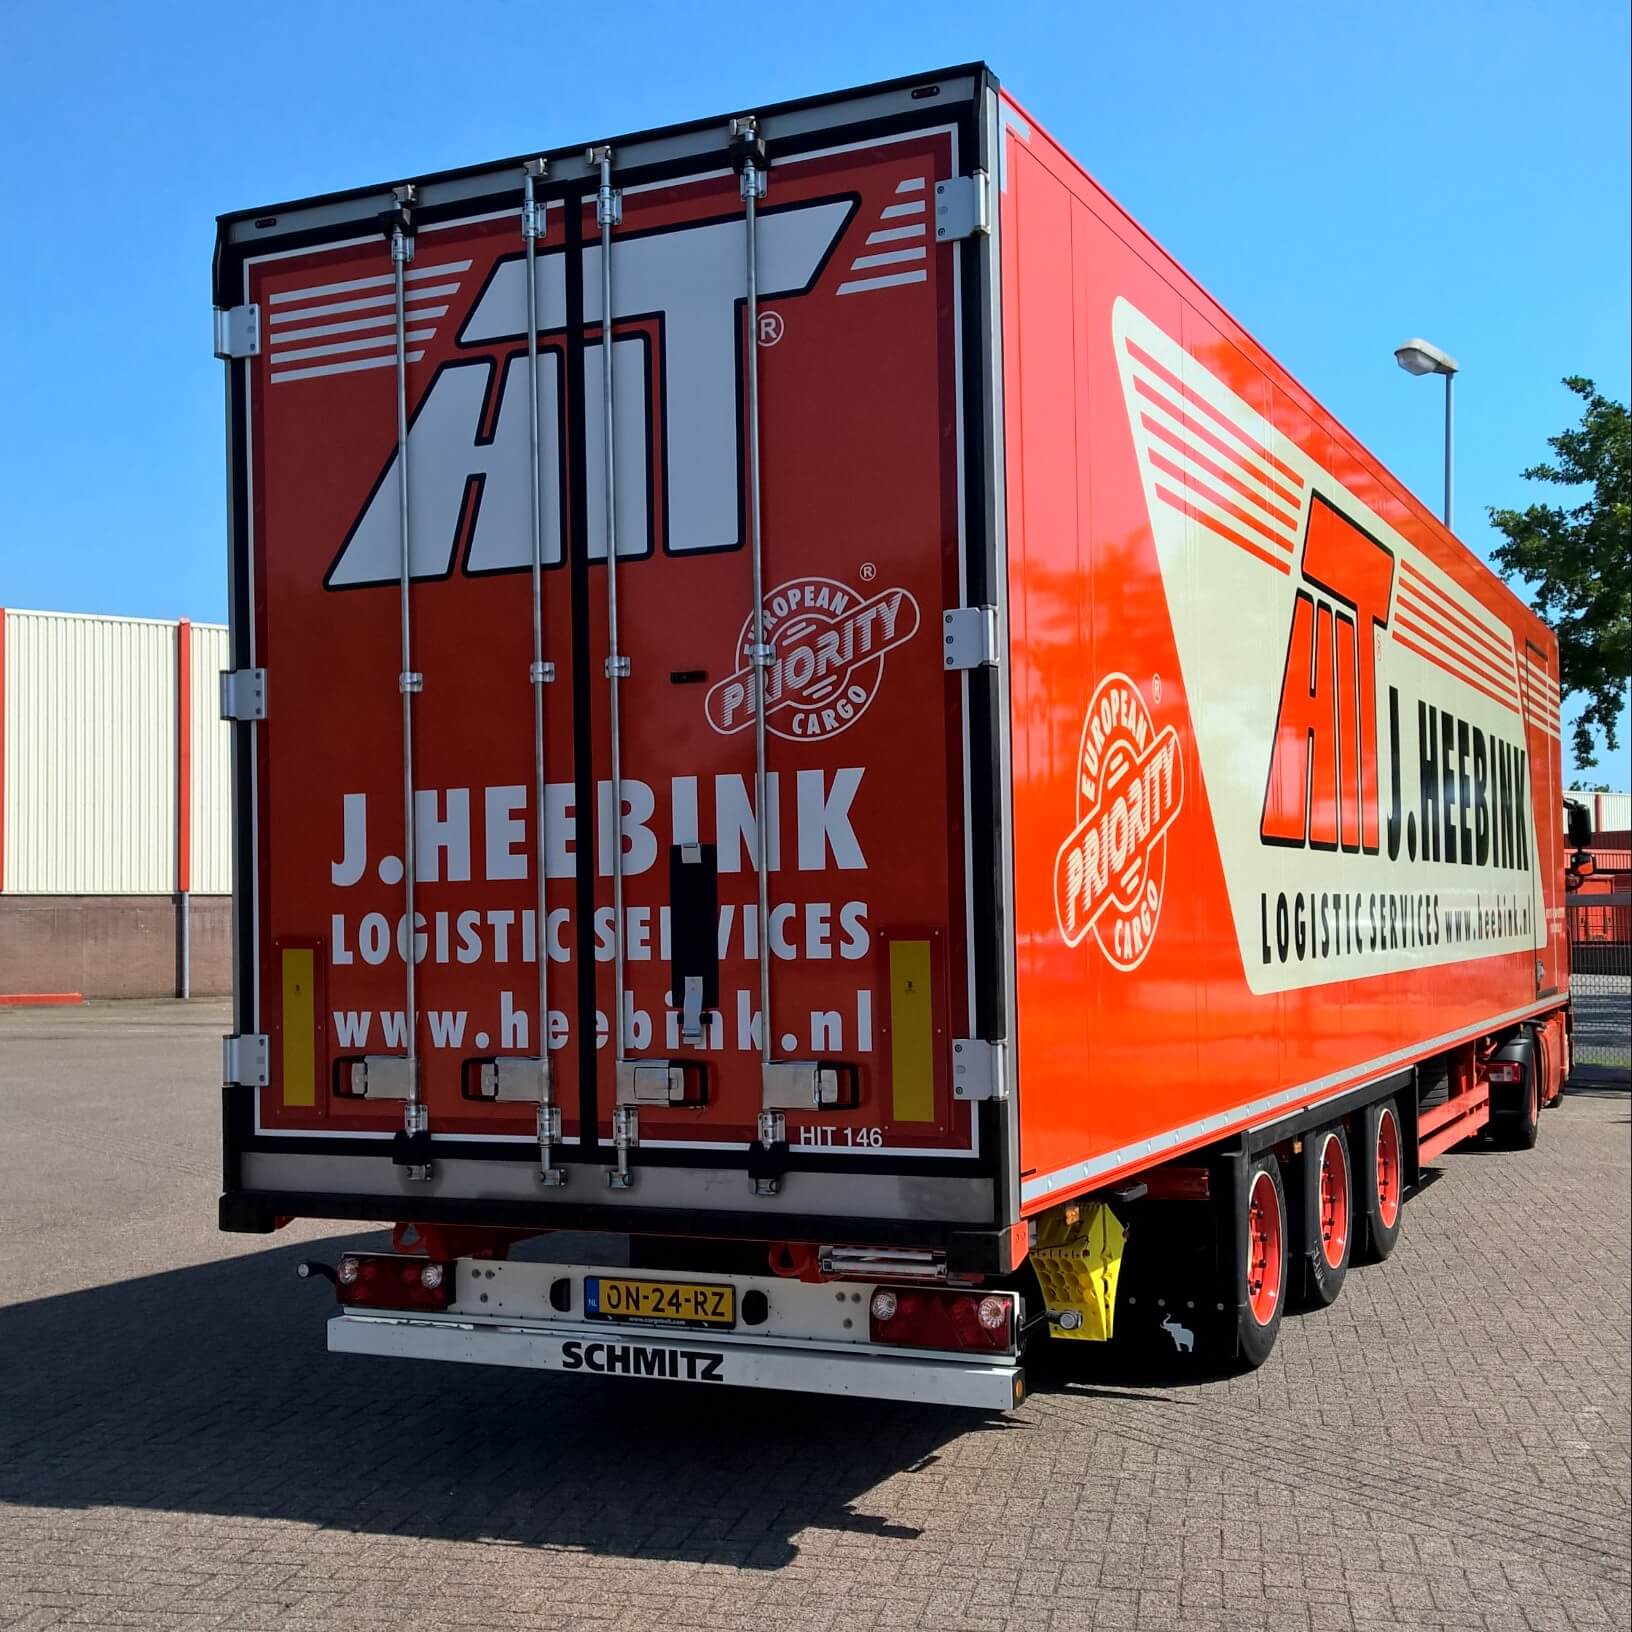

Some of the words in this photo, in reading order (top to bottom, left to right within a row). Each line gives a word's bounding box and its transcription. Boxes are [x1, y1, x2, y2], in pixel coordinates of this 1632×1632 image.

[720, 592, 903, 728] PRIORITY
[792, 685, 867, 735] CARGO
[1081, 687, 1147, 802] EUROPEAN
[1387, 686, 1530, 872] J.HEEBINK
[331, 767, 869, 887] J.HEEBINK
[1065, 735, 1176, 932] PRIORITY
[331, 907, 571, 965] LOGISTIC
[1114, 879, 1159, 960] CARGO
[1261, 891, 1363, 965] LOGISTIC
[1369, 893, 1440, 953] SERVICES
[1444, 893, 1532, 944] www.heebink.nl
[800, 1125, 837, 1147] HIT
[843, 1127, 883, 1148] 146
[606, 1284, 726, 1318] ON-24-RZ
[561, 1340, 724, 1382] SCHMITZ
